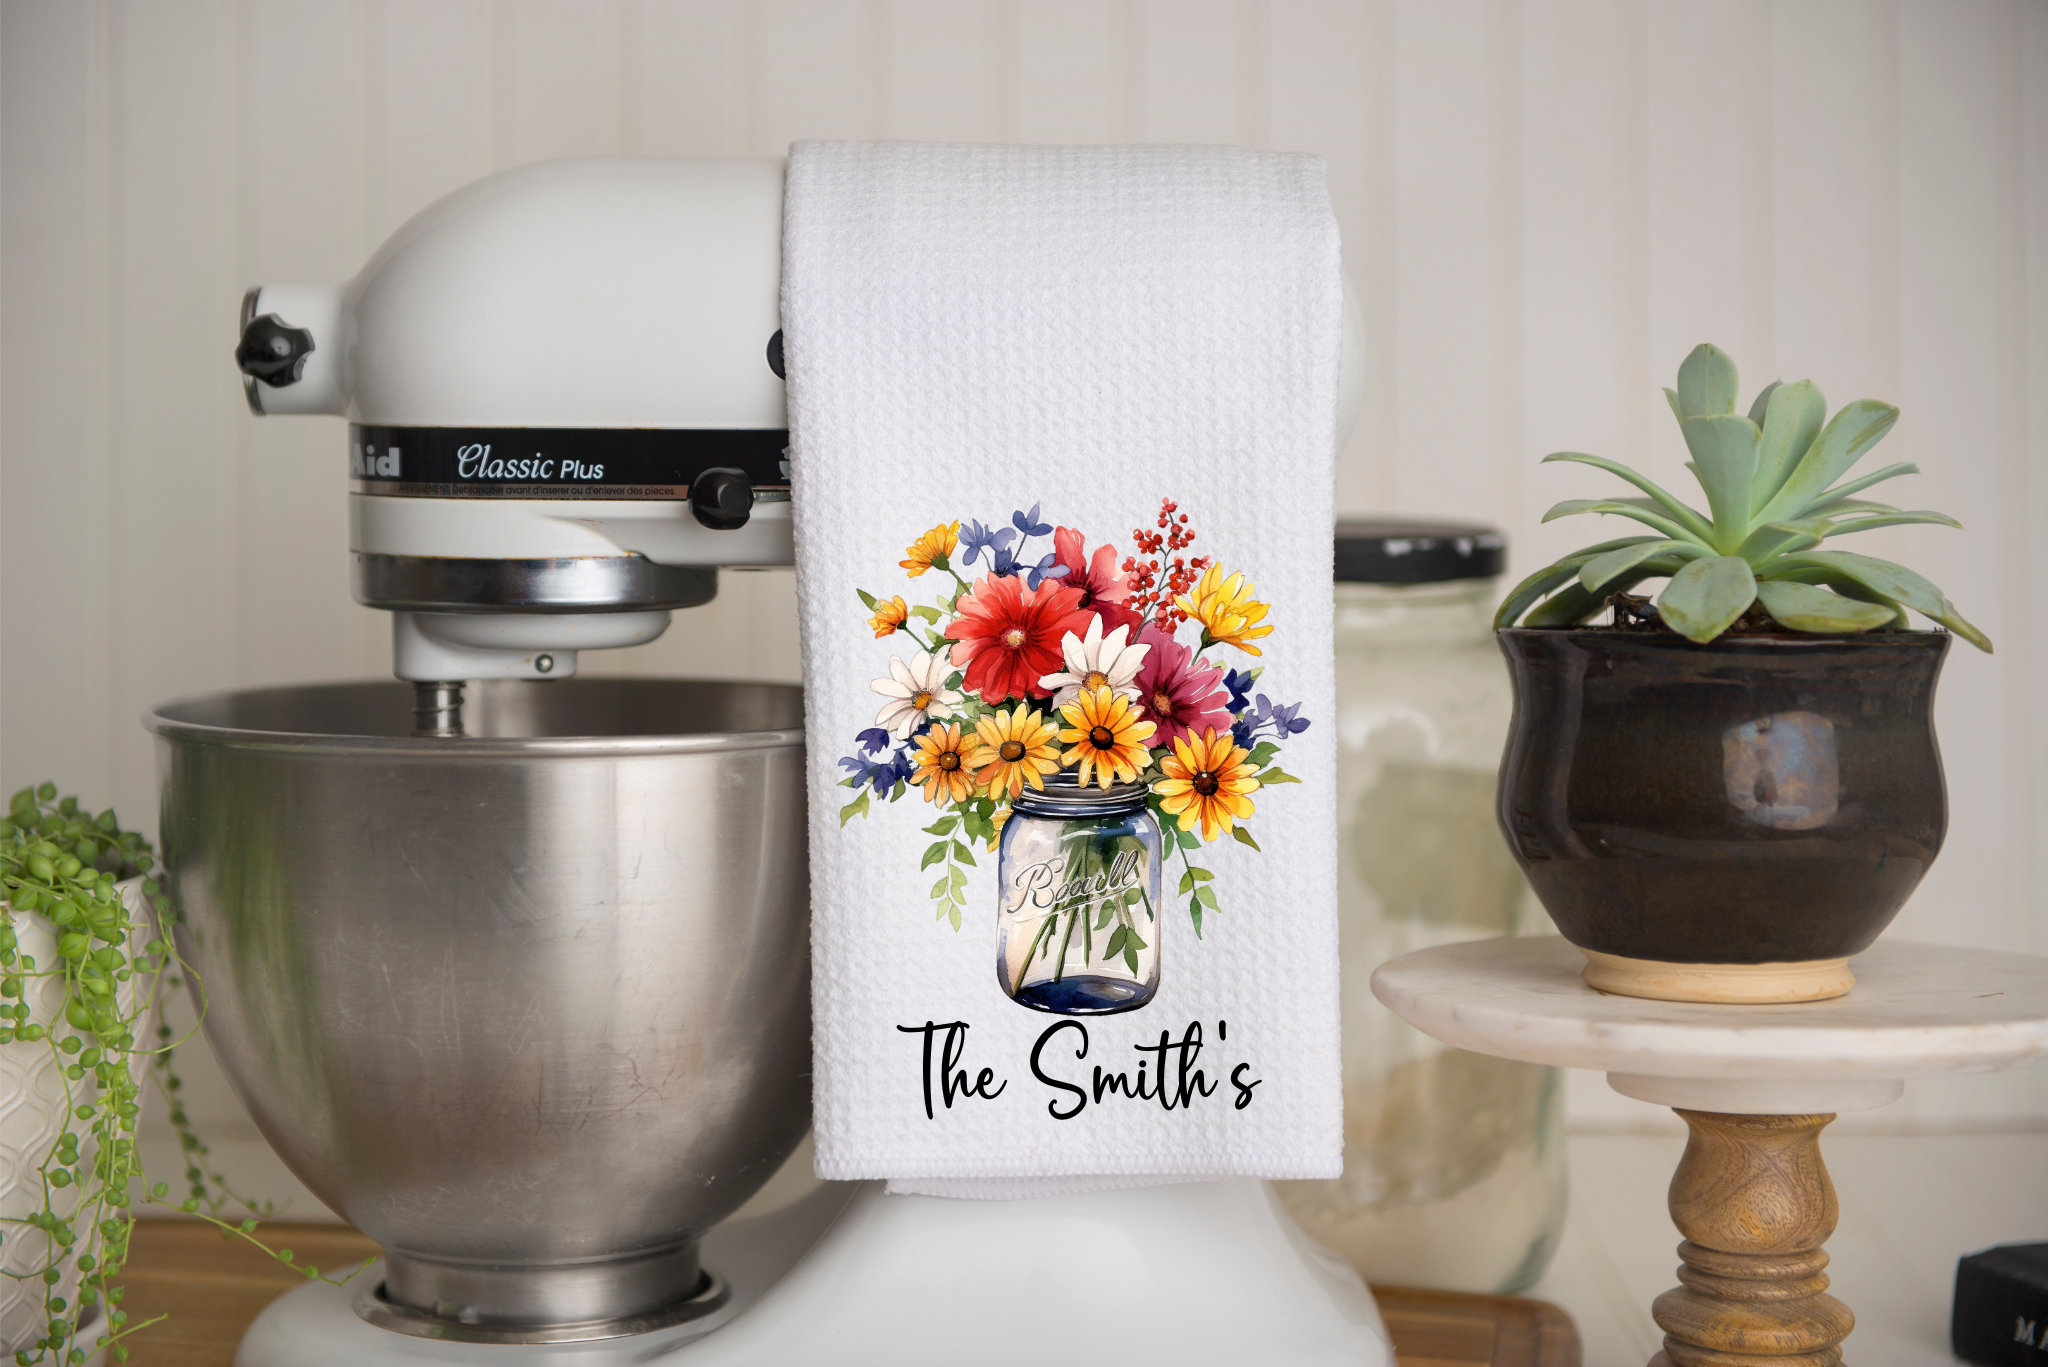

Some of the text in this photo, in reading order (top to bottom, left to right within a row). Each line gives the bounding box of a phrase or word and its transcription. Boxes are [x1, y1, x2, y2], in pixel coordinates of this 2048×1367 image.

[457, 443, 605, 479] Classic Plus
[452, 485, 504, 495] Debrancher
[505, 486, 531, 495] avant
[534, 485, 569, 496] d'inserer
[571, 487, 583, 495] ou
[585, 486, 627, 496] d'enlever
[627, 486, 643, 496] des
[645, 486, 677, 497] pieces.
[896, 1019, 1263, 1120] The Smith's
